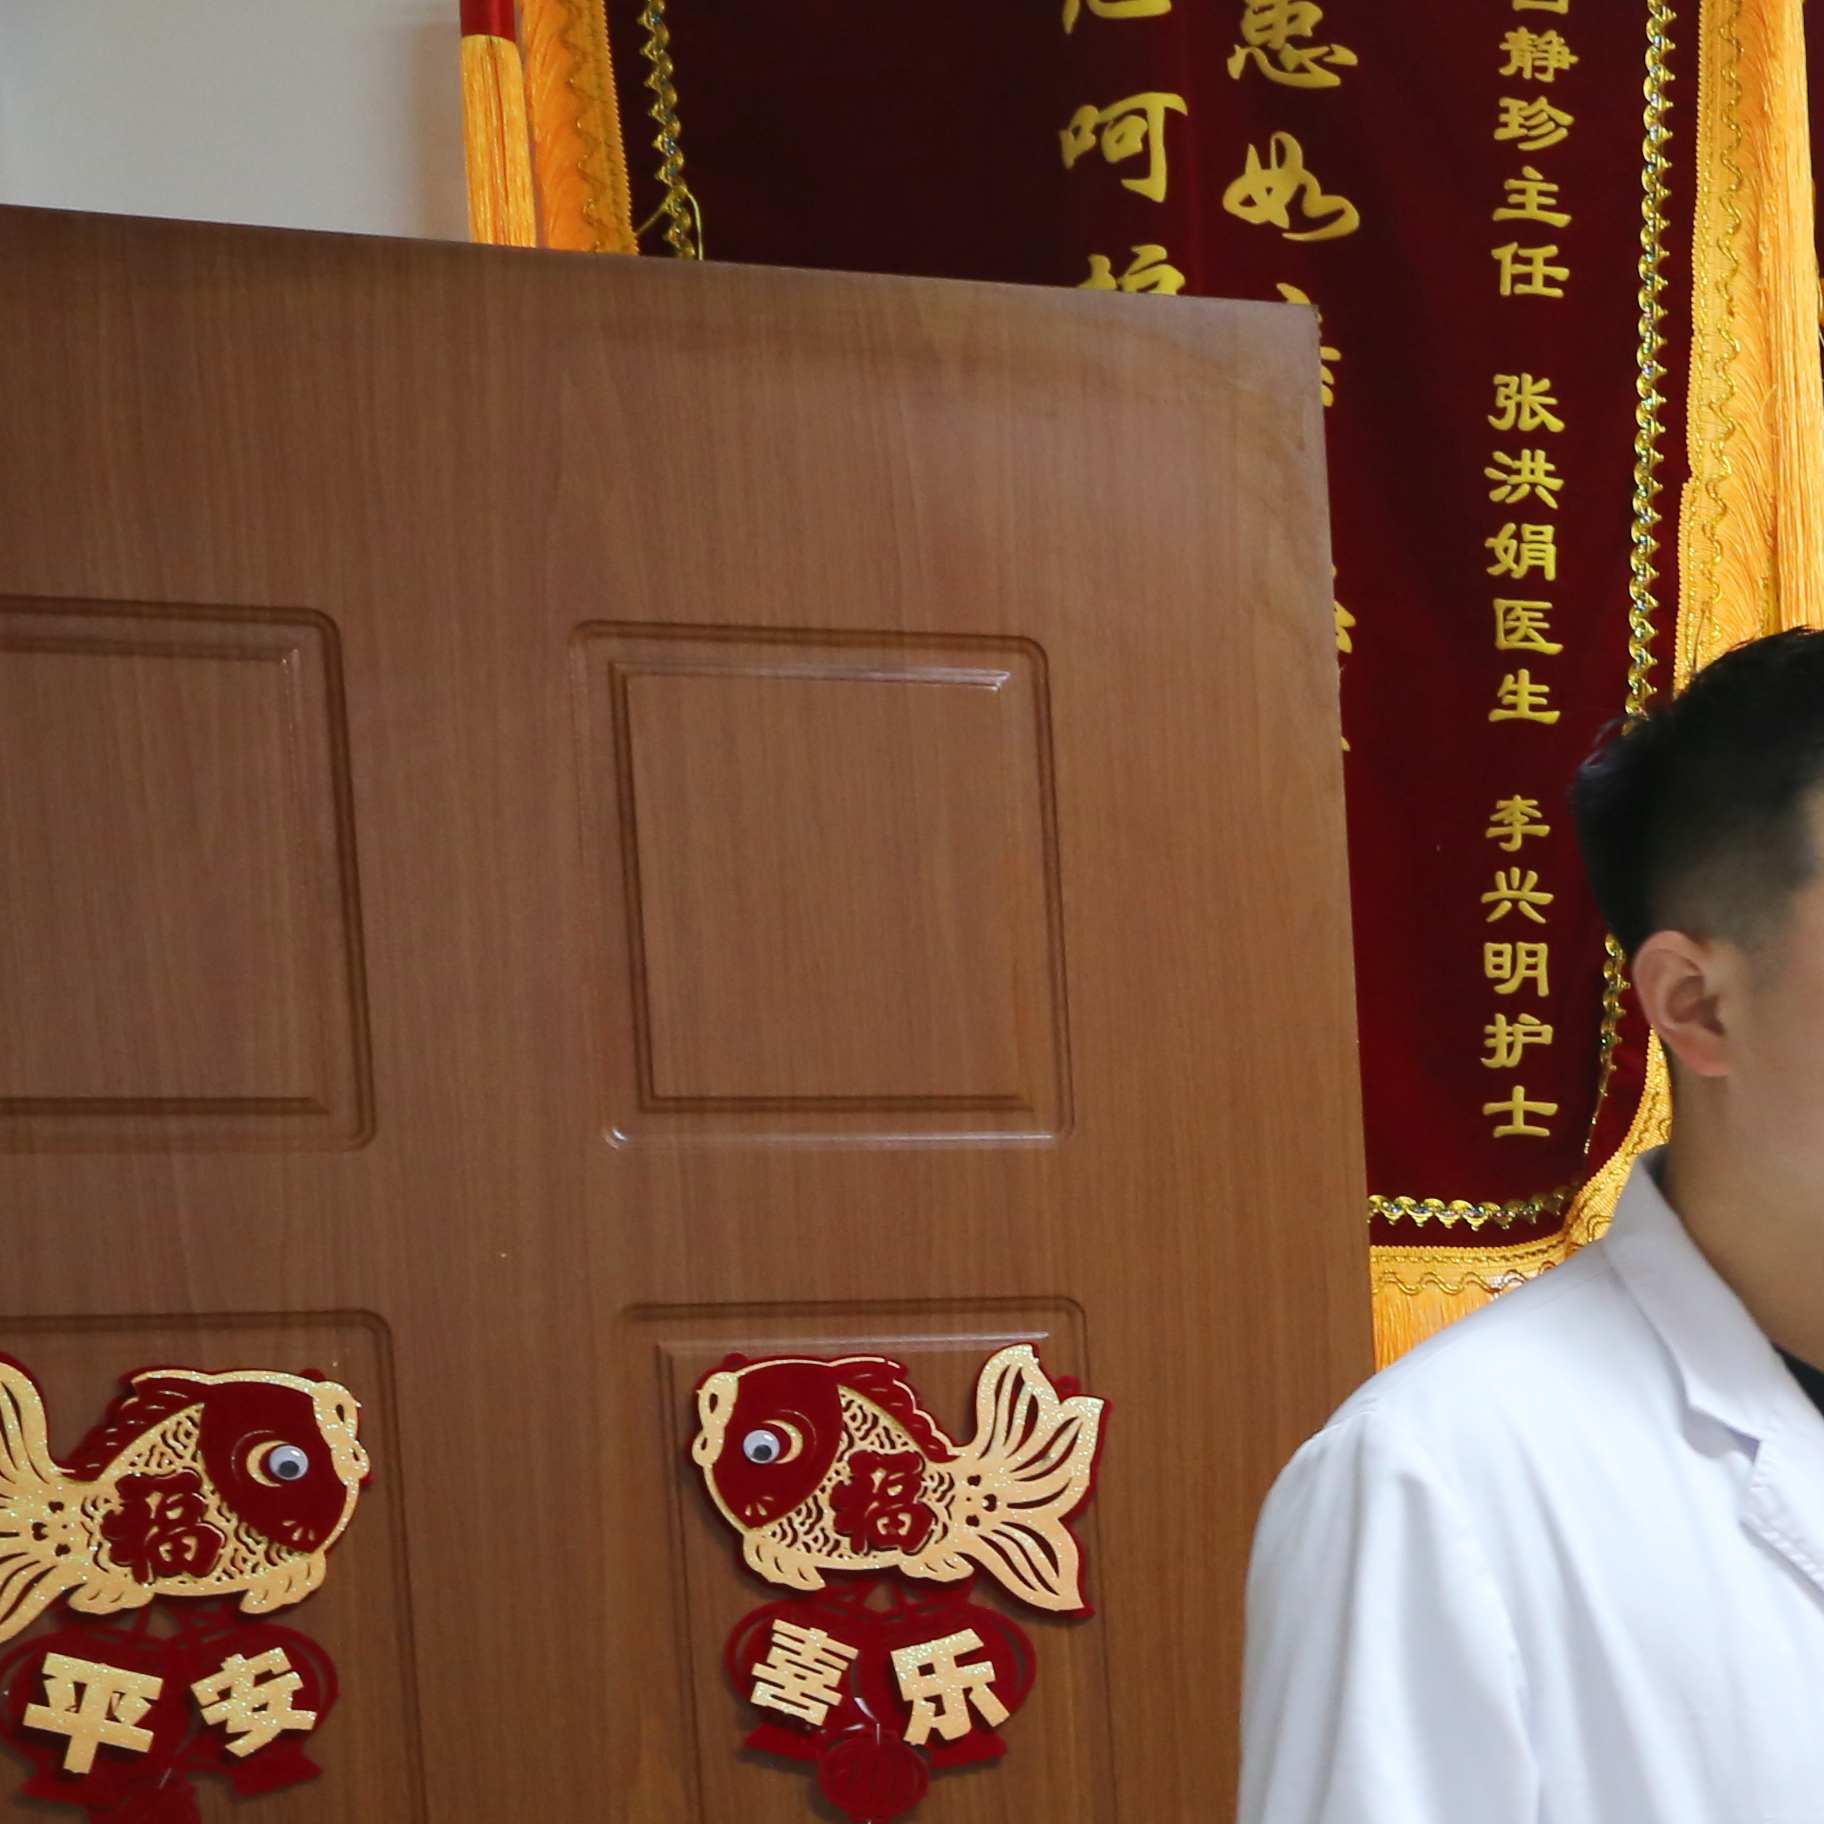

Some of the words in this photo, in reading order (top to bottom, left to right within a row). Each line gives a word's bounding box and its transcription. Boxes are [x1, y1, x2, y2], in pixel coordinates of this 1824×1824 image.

[1484, 372, 1565, 724] 张洪娟医生
[1481, 794, 1558, 1137] 李兴明护士
